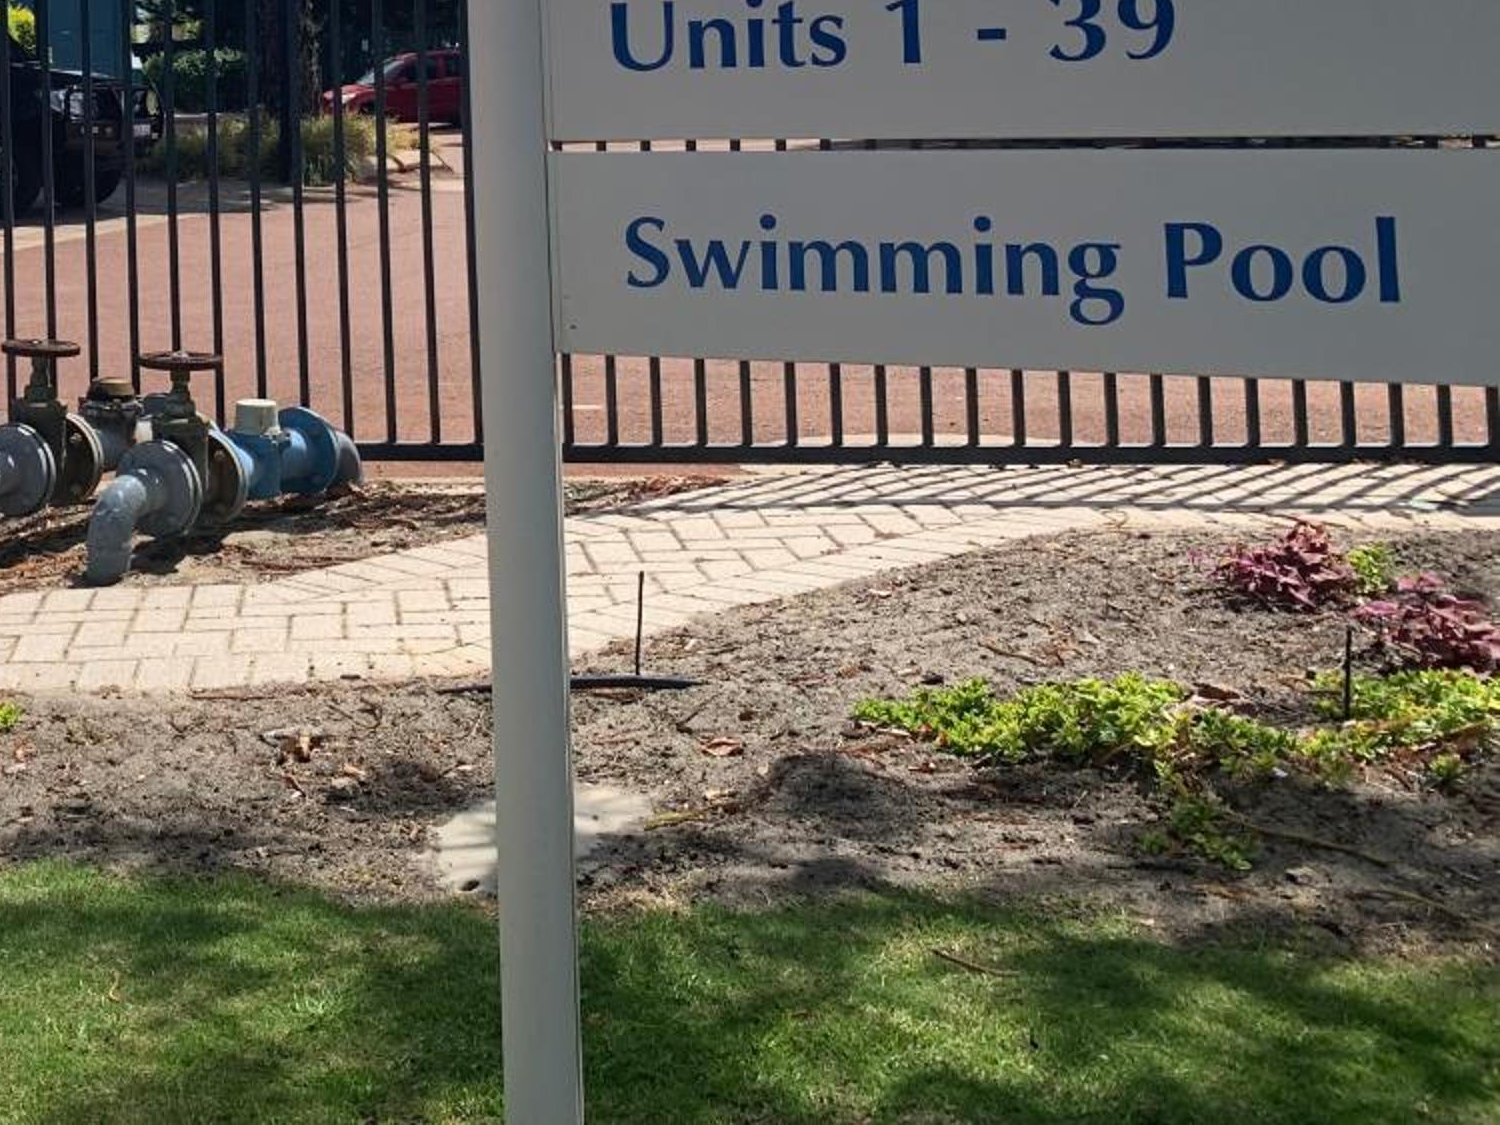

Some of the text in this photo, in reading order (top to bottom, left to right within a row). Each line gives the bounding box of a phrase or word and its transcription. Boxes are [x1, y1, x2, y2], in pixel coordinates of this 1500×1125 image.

[976, 26, 1007, 41] -
[624, 214, 1401, 325] Swimming Pool
